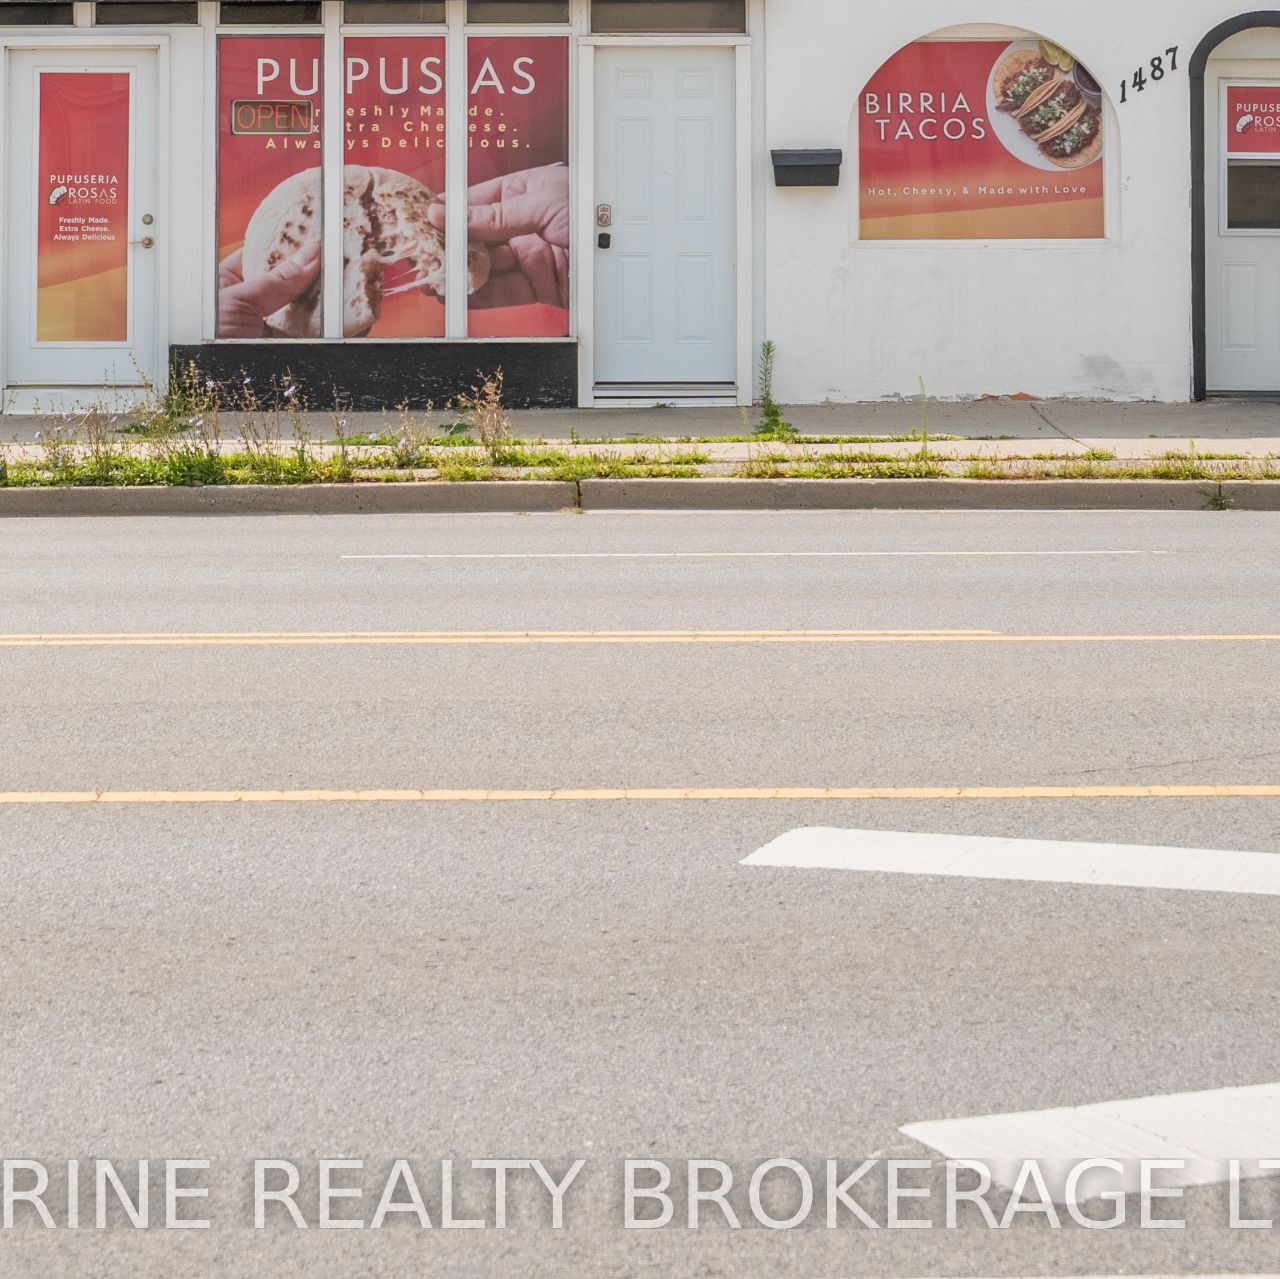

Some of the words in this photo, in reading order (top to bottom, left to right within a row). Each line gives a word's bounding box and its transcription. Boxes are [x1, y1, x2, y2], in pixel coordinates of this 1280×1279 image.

[257, 56, 537, 96] PUPUSAS
[1120, 45, 1178, 104] 1487
[865, 91, 971, 114] BIRRIA
[236, 104, 309, 129] OPEN
[315, 104, 409, 118] reshly
[420, 105, 504, 117] Made.
[312, 121, 380, 133] xtra
[403, 121, 517, 132] Cheese.
[874, 117, 986, 140] TACOS
[266, 137, 369, 150] Always
[381, 136, 530, 148] Delicious.
[50, 174, 118, 184] PUPUSERIA
[68, 187, 117, 199] ROSAS
[868, 187, 897, 196] Hot,
[903, 186, 957, 196] Cheesy,
[962, 186, 969, 195] &
[978, 186, 1013, 194] Made
[1018, 185, 1049, 194] with
[1054, 185, 1087, 194] Love
[59, 216, 86, 224] Freshly
[53, 233, 79, 242] Always
